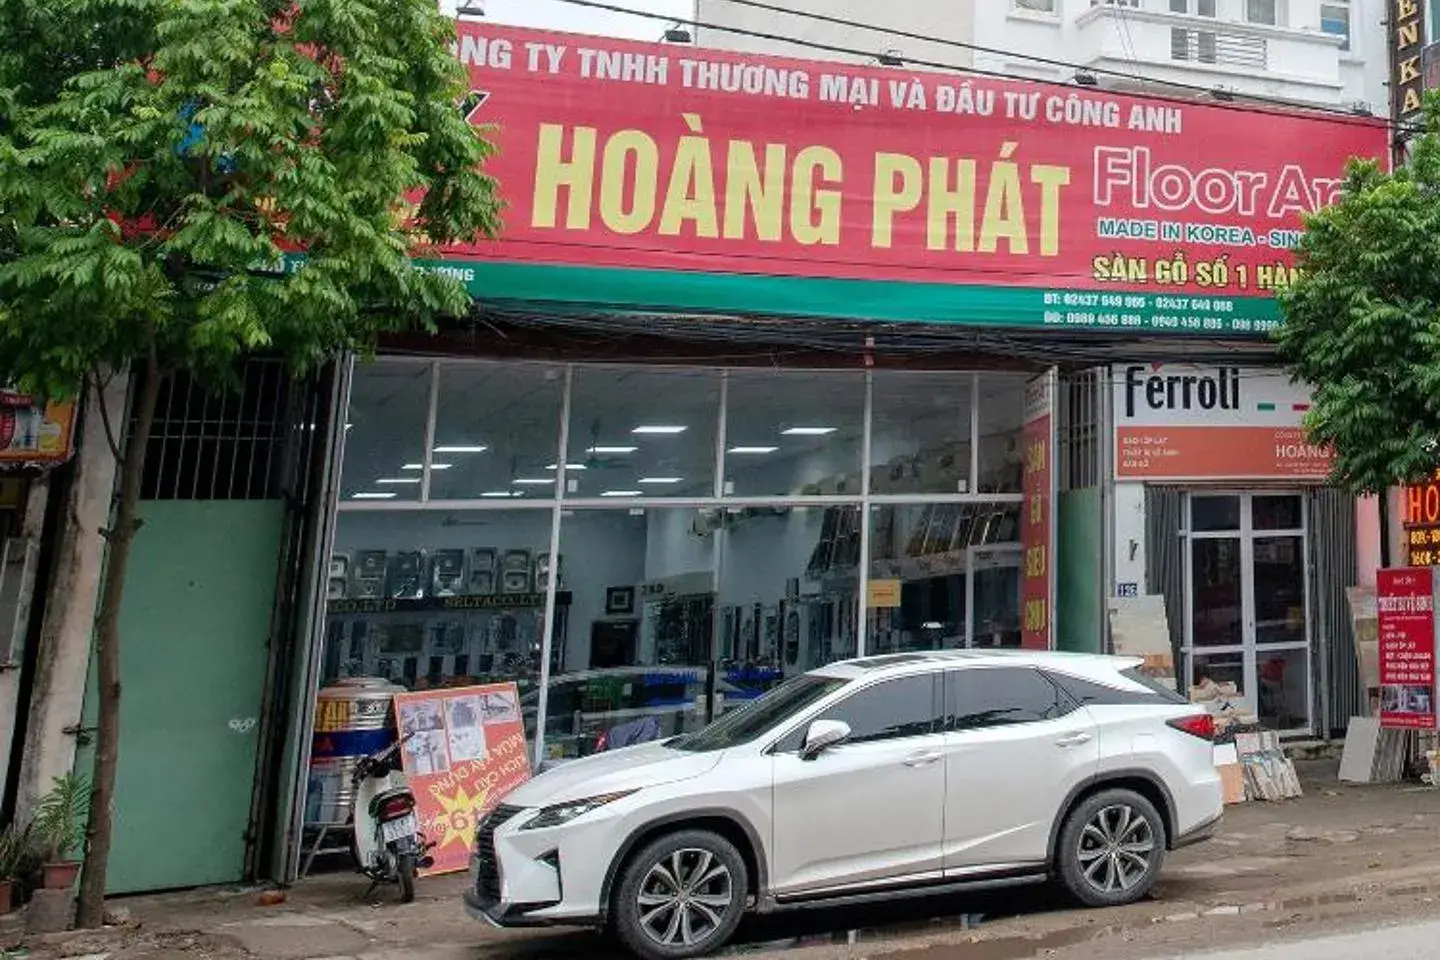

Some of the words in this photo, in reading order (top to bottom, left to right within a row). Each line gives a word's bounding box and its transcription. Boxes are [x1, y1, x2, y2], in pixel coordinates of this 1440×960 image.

[525, 41, 566, 75] TY
[578, 47, 668, 86] TNHH
[680, 57, 809, 100] THƯƠNG
[819, 73, 879, 111] MẠI
[890, 76, 927, 111] VÀ
[936, 80, 995, 117] ĐẦU
[1003, 90, 1042, 121] TƯ
[1046, 94, 1120, 129] CÔNG
[1128, 104, 1182, 135] ANH
[531, 113, 843, 247] HOÀNG
[871, 141, 1070, 257] PHÁT
[1098, 218, 1157, 240] MADE
[1162, 221, 1181, 241] IN
[1186, 224, 1255, 247] KOREA
[1268, 230, 1302, 249] SIN
[1155, 250, 1188, 285] GỖ
[1195, 253, 1231, 287] SỐ
[1236, 264, 1247, 289] 1
[1126, 366, 1239, 417] Ferroli
